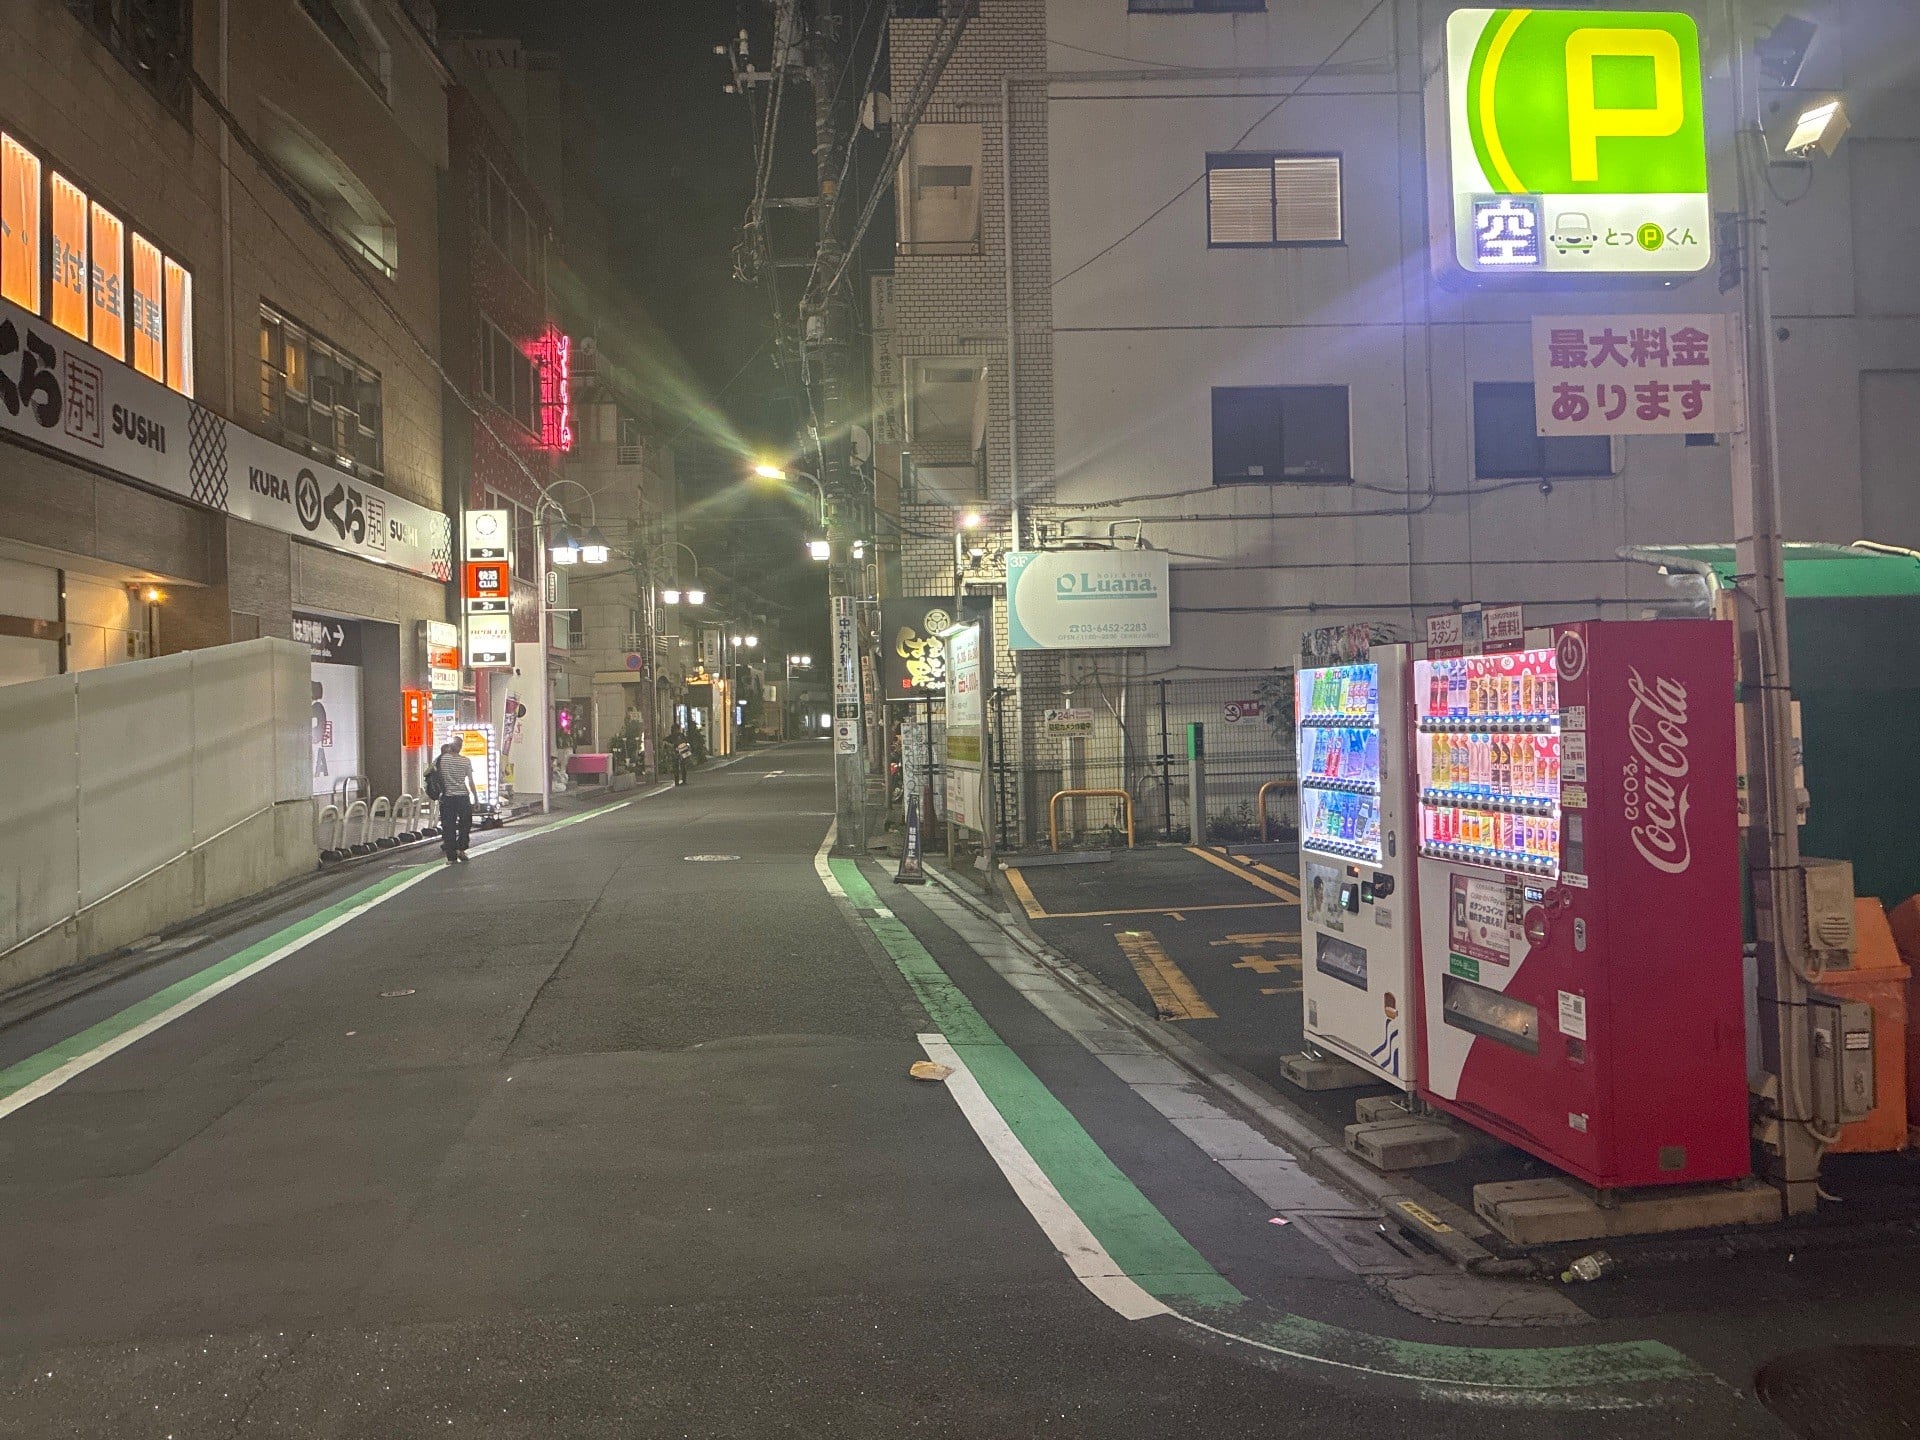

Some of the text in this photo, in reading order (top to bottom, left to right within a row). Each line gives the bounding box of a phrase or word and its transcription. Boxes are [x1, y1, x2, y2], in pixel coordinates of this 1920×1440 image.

[1566, 29, 1684, 181] P
[1475, 199, 1538, 265] 空
[1548, 327, 1710, 369] 最大料金
[1551, 379, 1712, 422] あります
[112, 404, 166, 454] SUSHI
[249, 465, 291, 504] KURA
[324, 483, 366, 545] くら
[390, 519, 419, 548] SUSHI
[1010, 556, 1027, 567] 3F
[478, 580, 498, 588] CLUB
[1431, 628, 1459, 645] スタンプ
[1057, 711, 1075, 721] 24H
[1628, 664, 1691, 873] Coca-Cola
